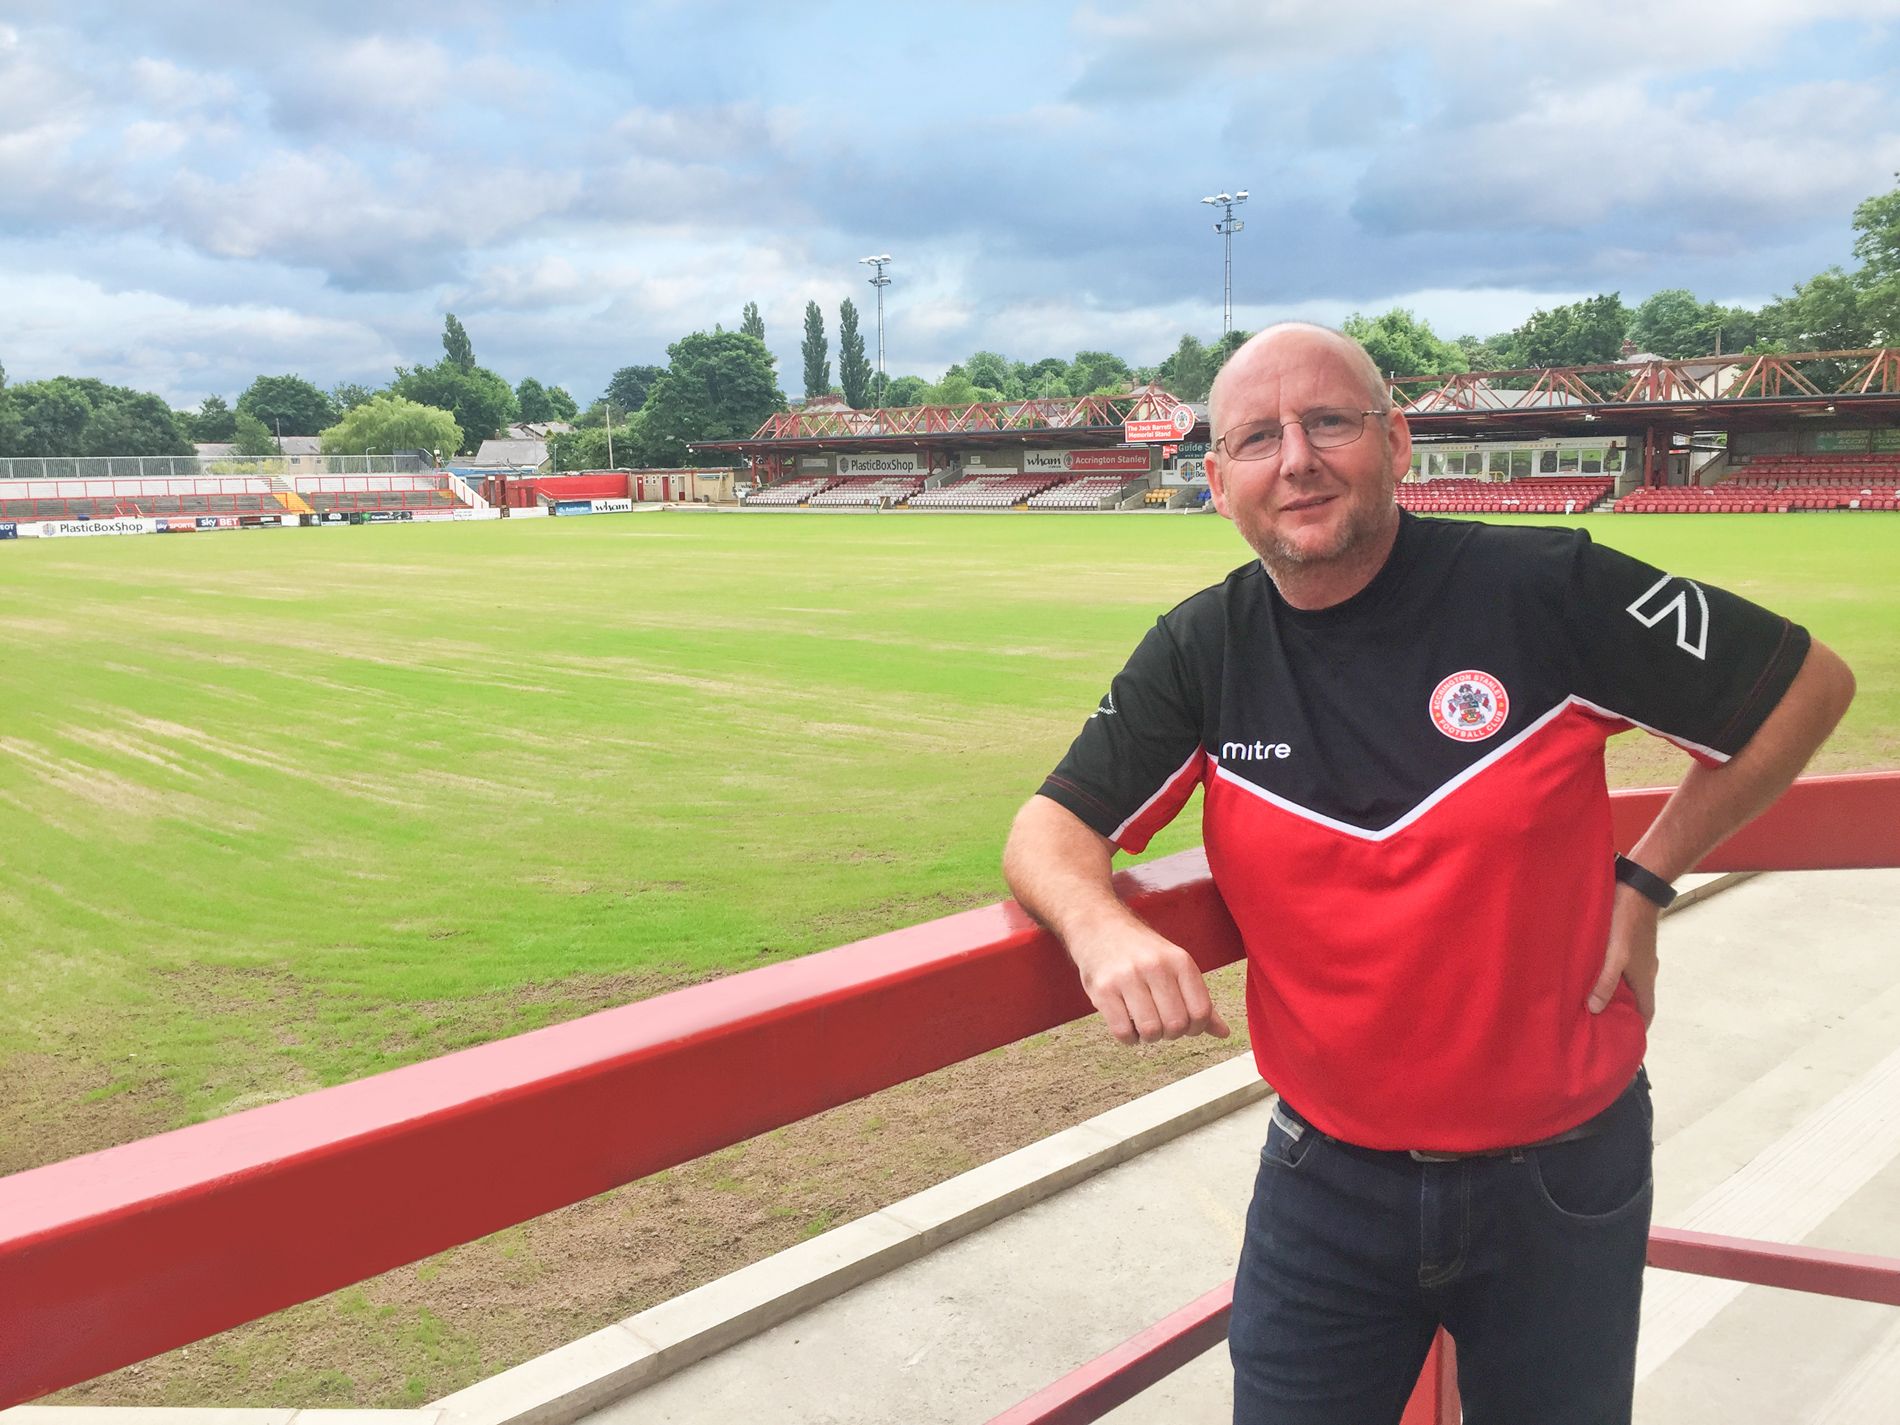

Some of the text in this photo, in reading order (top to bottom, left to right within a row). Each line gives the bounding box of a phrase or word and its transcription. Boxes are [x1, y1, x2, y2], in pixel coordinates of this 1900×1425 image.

[1027, 453, 1061, 466] wham
[1075, 455, 1147, 465] Accrington Stanley
[851, 459, 914, 473] PlasticBoxShop
[595, 501, 629, 511] wham
[60, 522, 143, 533] PlasticBoxShop
[157, 522, 168, 530] sky
[201, 517, 239, 527] sky BET
[1433, 674, 1504, 710] ACCRINGTON STANLEY
[1439, 711, 1504, 737] FOOTBALL CLUB
[1222, 740, 1292, 760] mitre
